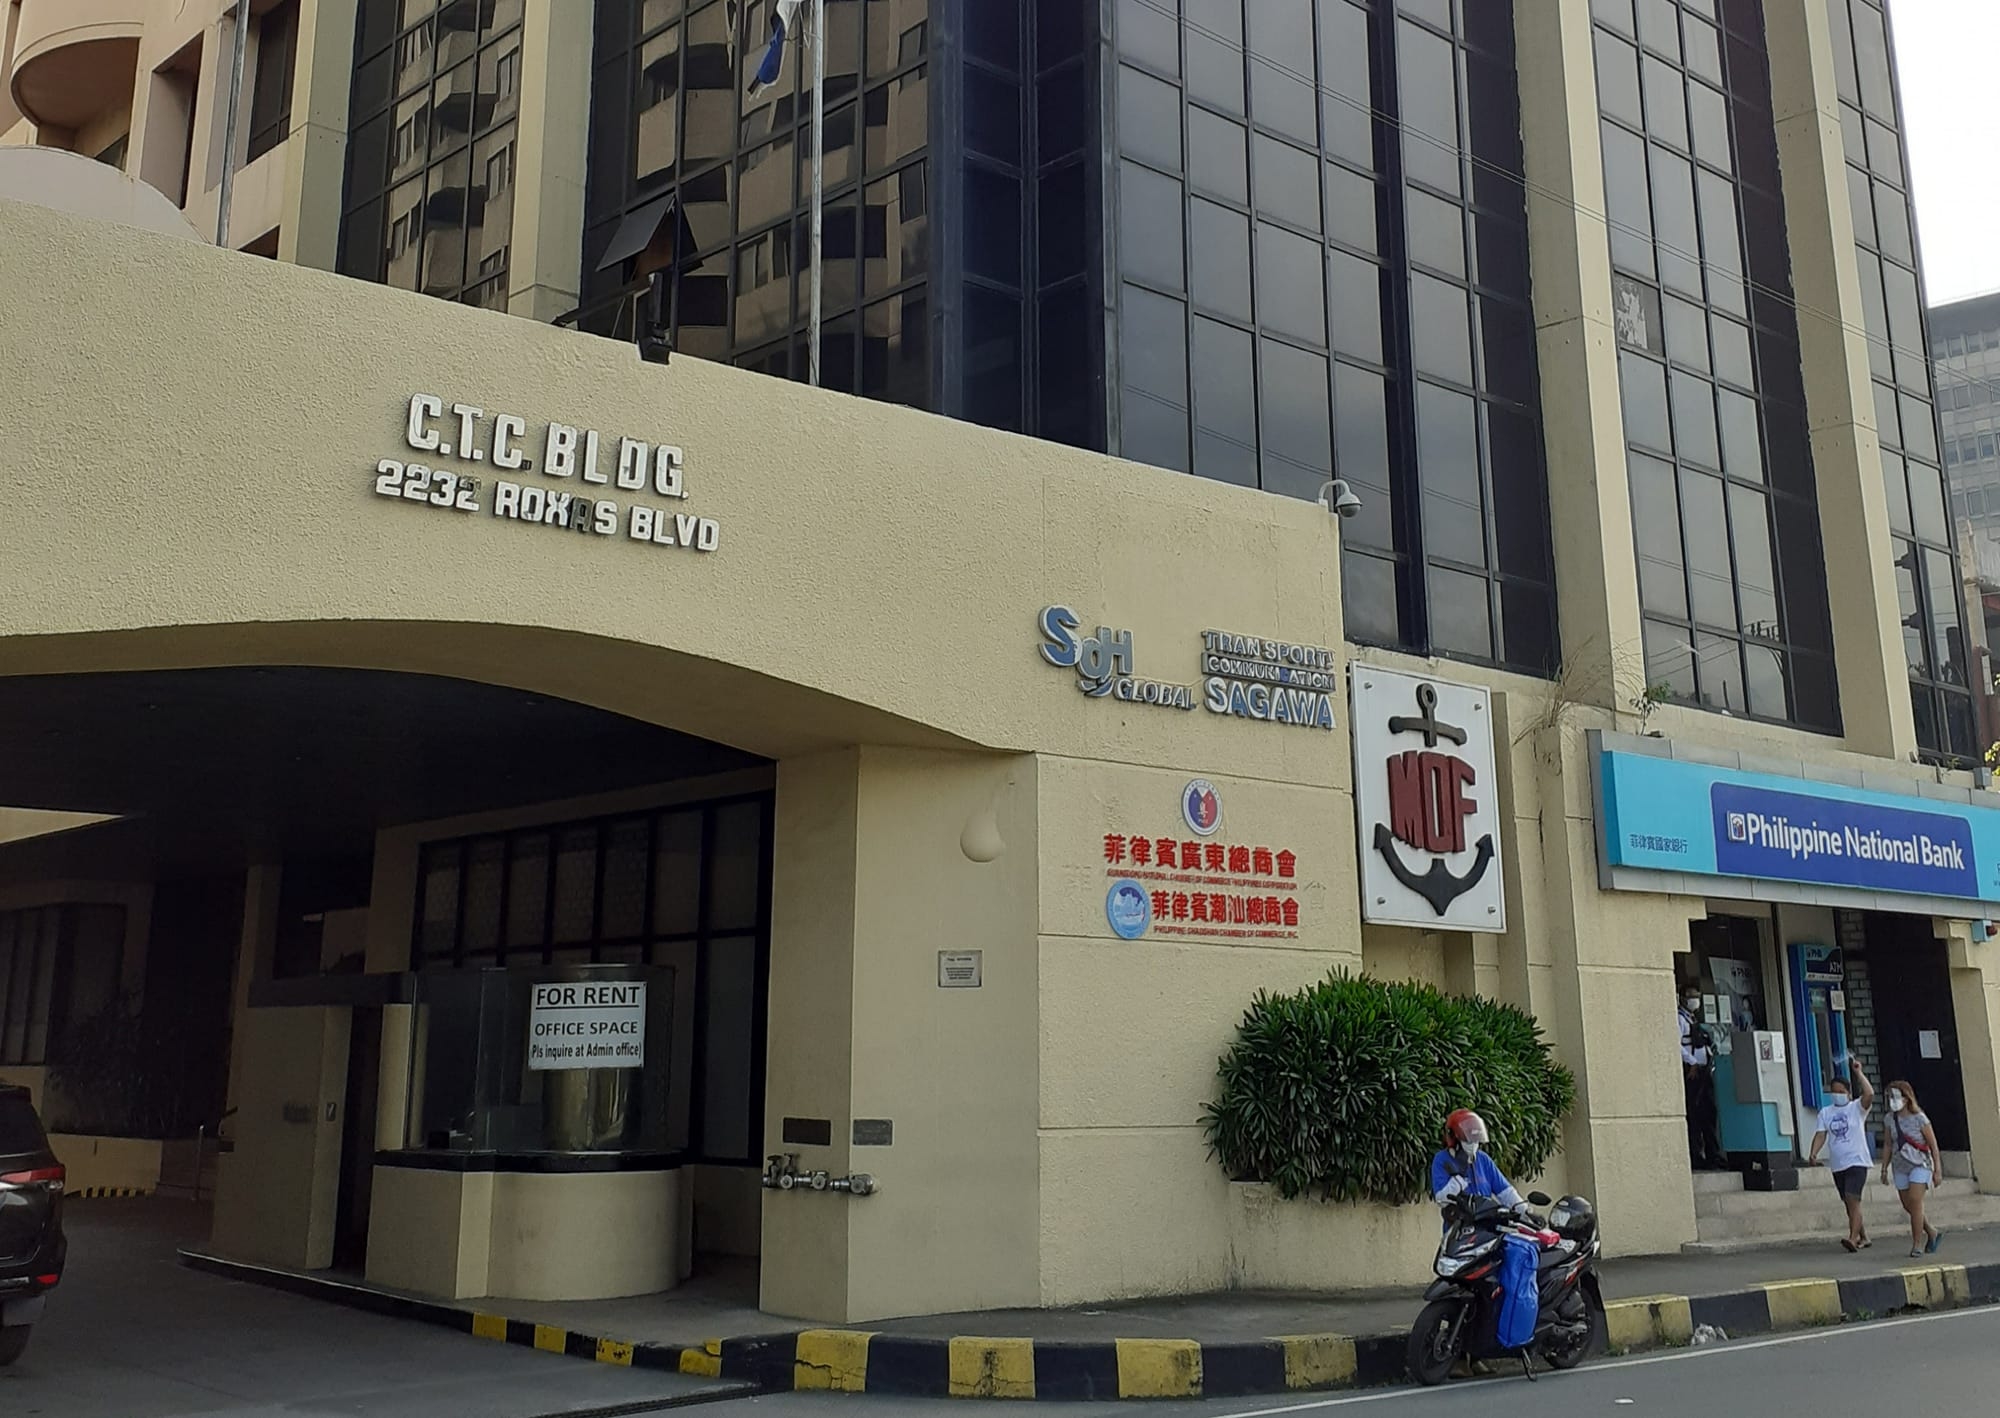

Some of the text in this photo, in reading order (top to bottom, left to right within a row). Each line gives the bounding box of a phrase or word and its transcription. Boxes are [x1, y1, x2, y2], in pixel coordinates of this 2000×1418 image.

[375, 458, 720, 552] 2232 ROXAS BLVD
[1206, 655, 1335, 691] COMMUNICATION
[1113, 678, 1197, 712] GLOBAL
[1205, 676, 1337, 729] SAGAWA
[1103, 833, 1297, 878] 菲律賓廣東總商會
[1746, 812, 1965, 870] Philippine National Bank
[536, 986, 640, 1006] FOR RENT
[534, 1021, 638, 1036] OFFICE SPACE
[545, 1043, 573, 1062] inquire
[576, 1043, 584, 1057] at
[586, 1042, 613, 1057] Admin
